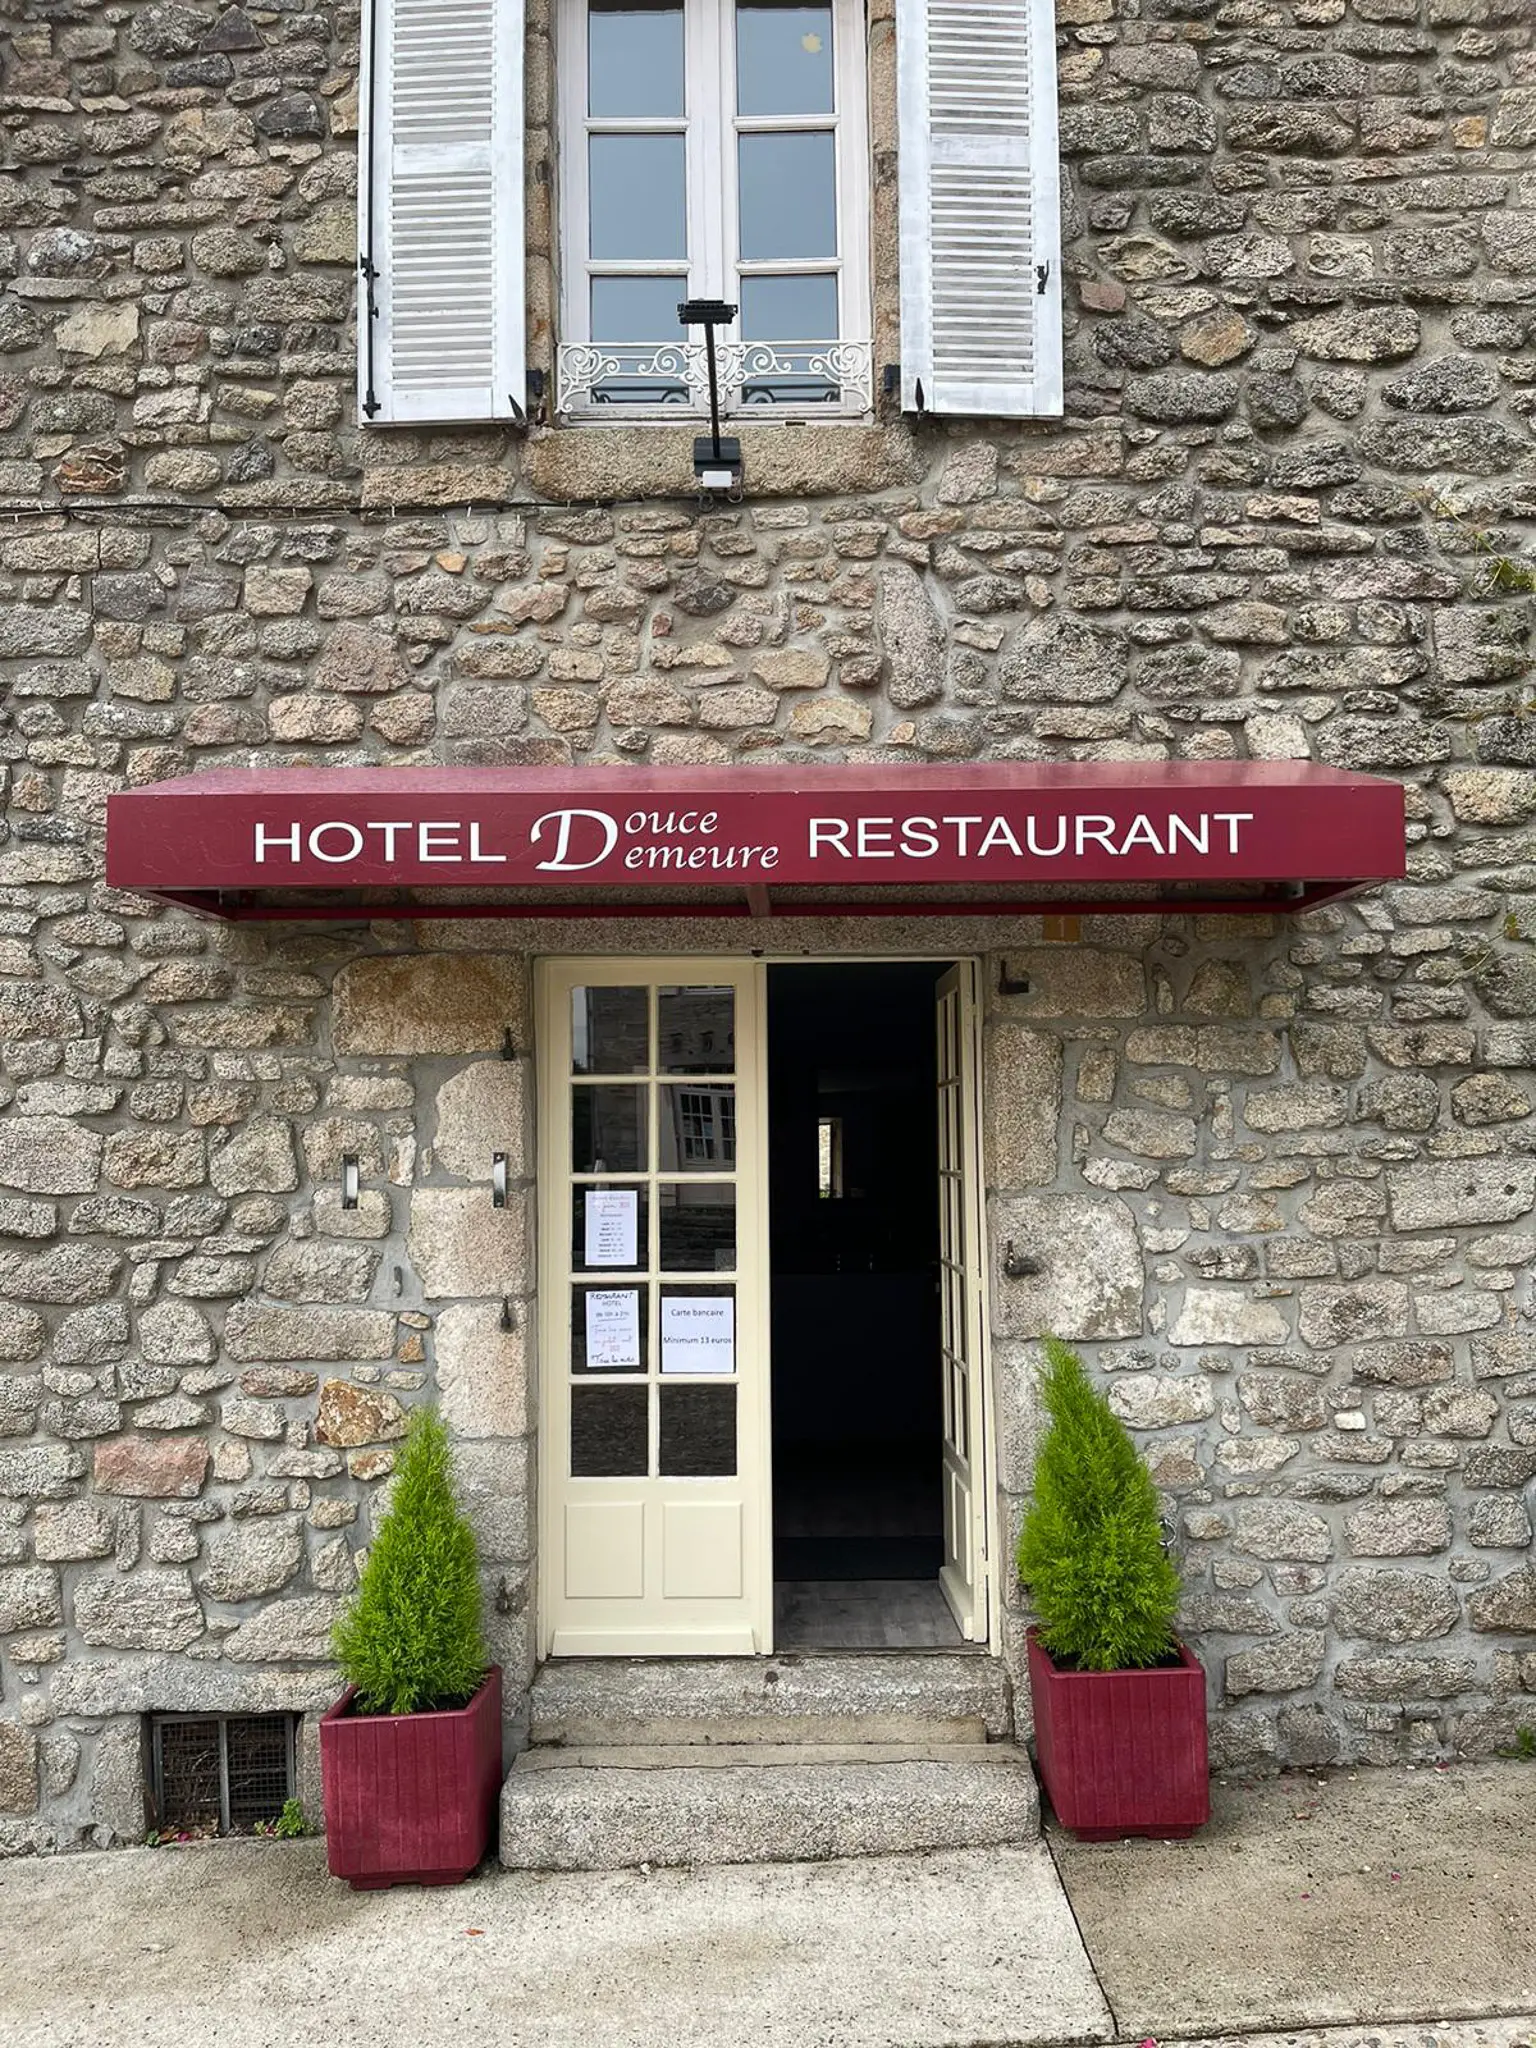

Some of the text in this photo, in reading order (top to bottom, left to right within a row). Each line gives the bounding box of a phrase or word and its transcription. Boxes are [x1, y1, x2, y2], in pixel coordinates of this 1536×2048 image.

[254, 821, 507, 864] HOTEL
[808, 813, 1255, 859] RESTAURANT
[670, 1308, 724, 1316] Carte bancaire
[663, 1336, 699, 1344] Minimum
[700, 1336, 710, 1344] 13
